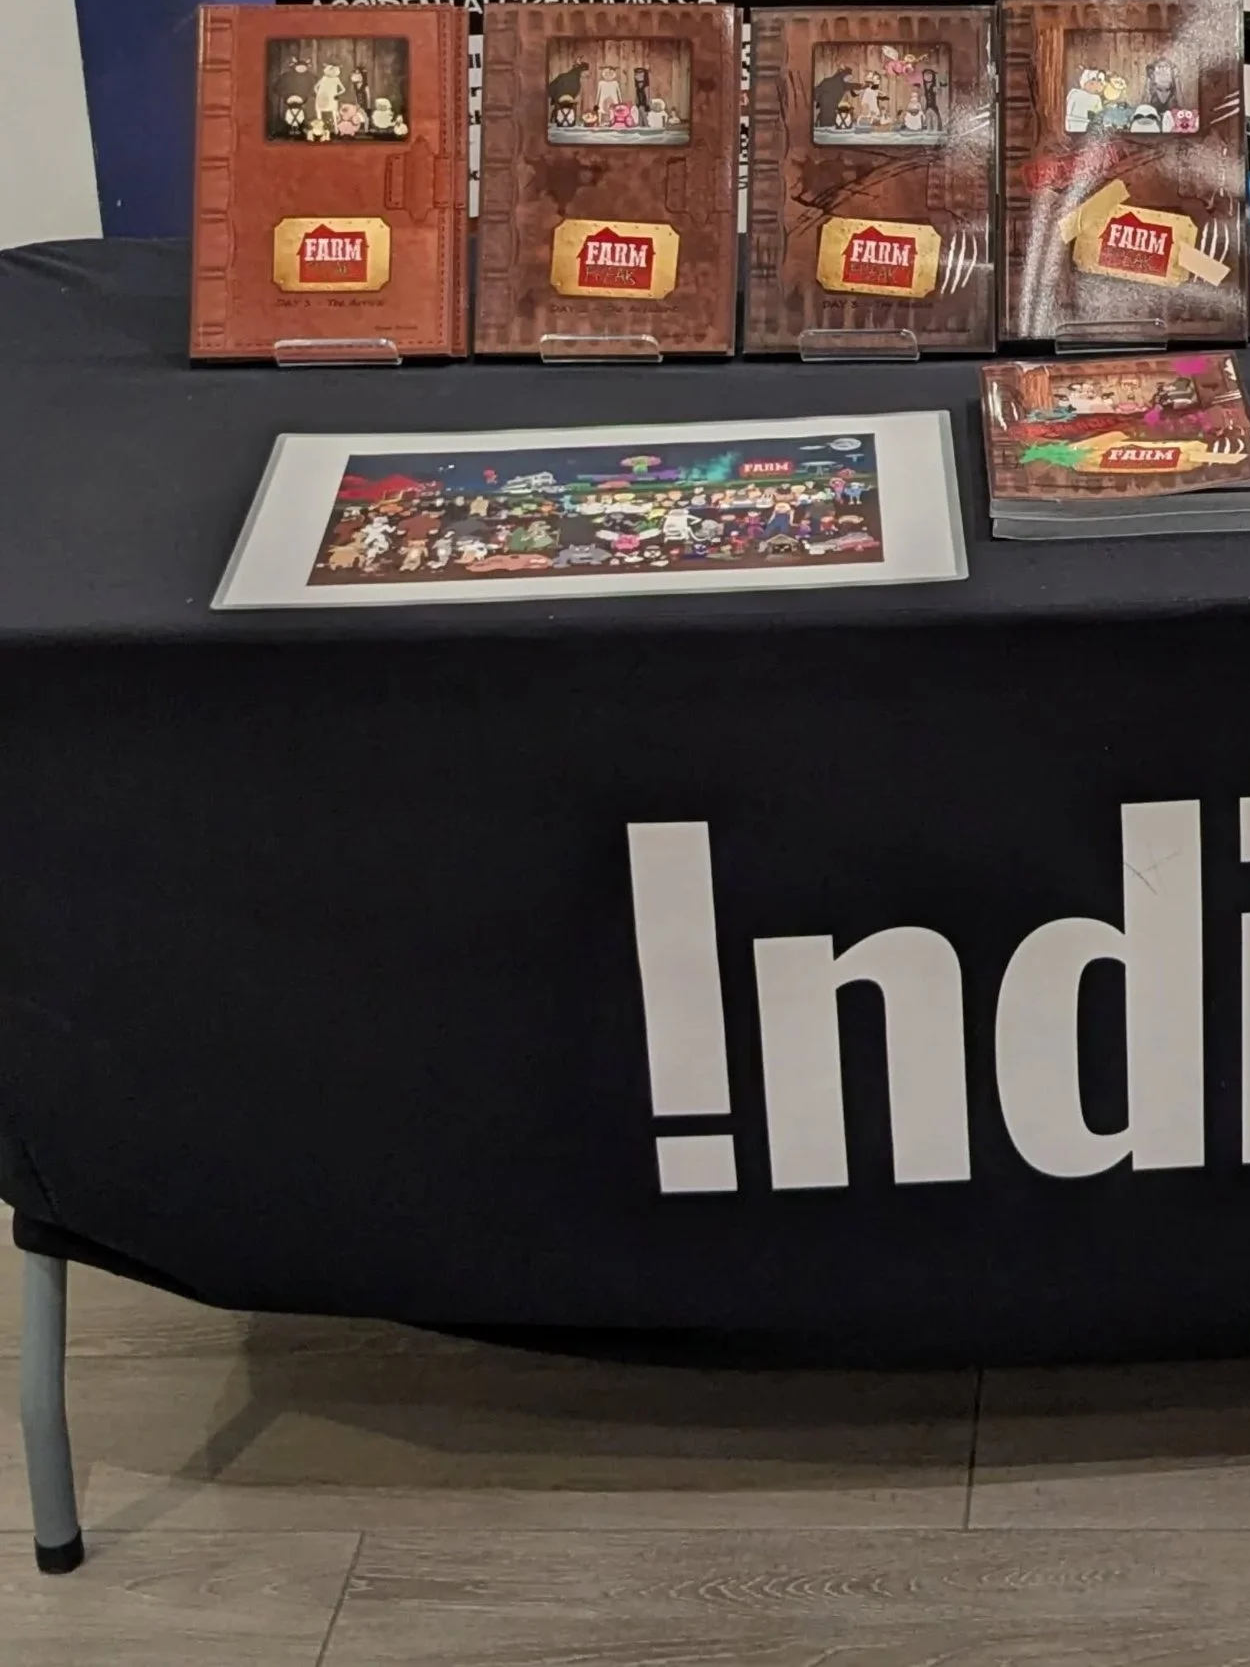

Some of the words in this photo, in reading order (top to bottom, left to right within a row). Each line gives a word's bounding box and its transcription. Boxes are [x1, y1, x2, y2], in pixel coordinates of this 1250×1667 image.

[304, 238, 363, 261] FARM
[1107, 224, 1168, 255] FARM
[585, 241, 648, 268] FARM
[850, 239, 911, 266] FARM
[744, 462, 790, 472] FARM
[1108, 448, 1175, 462] FARM
